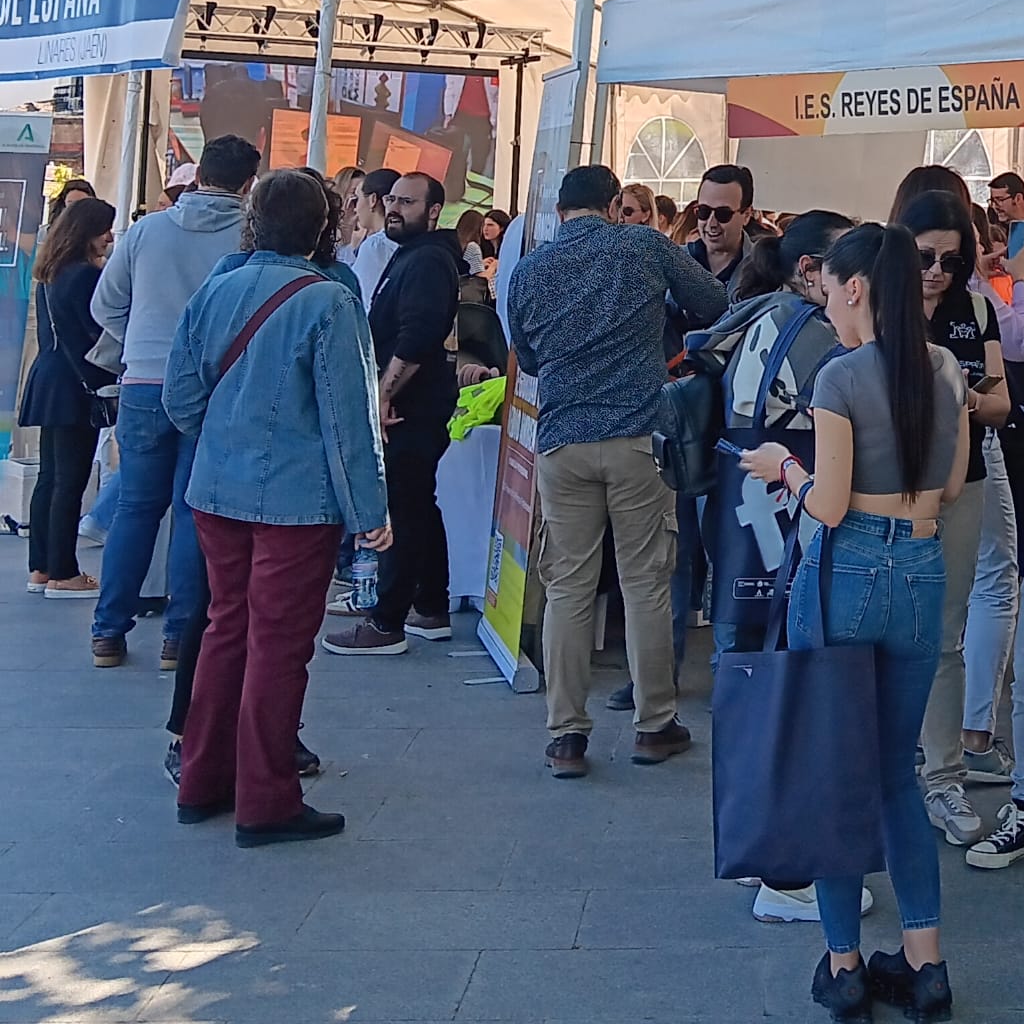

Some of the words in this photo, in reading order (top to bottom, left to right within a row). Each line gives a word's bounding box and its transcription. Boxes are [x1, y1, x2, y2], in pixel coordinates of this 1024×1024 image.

[794, 93, 836, 119] I.E.S.
[841, 89, 901, 118] REYES
[907, 87, 932, 114] DE
[938, 76, 1020, 113] ESPAÑA
